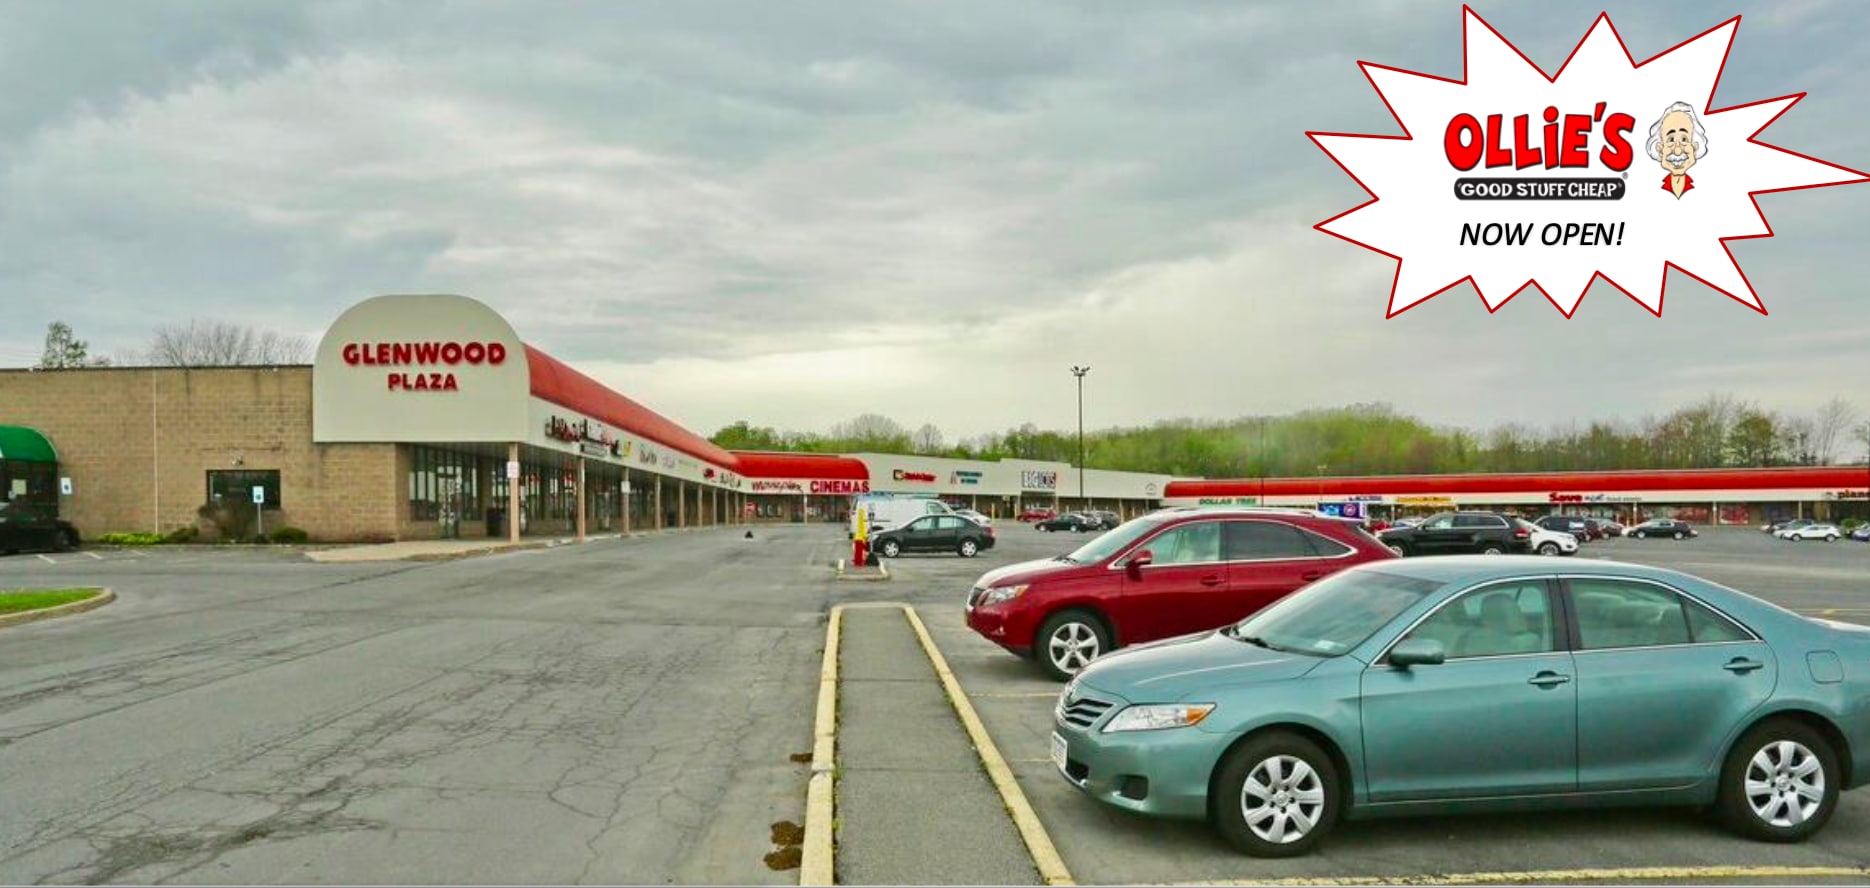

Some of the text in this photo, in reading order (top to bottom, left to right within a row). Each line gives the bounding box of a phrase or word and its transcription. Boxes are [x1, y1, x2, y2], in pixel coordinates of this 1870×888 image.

[342, 342, 507, 367] GLENWOOD
[388, 373, 458, 391] PLAZA
[810, 480, 870, 493] CINEMAS
[1549, 492, 1583, 502] Save
